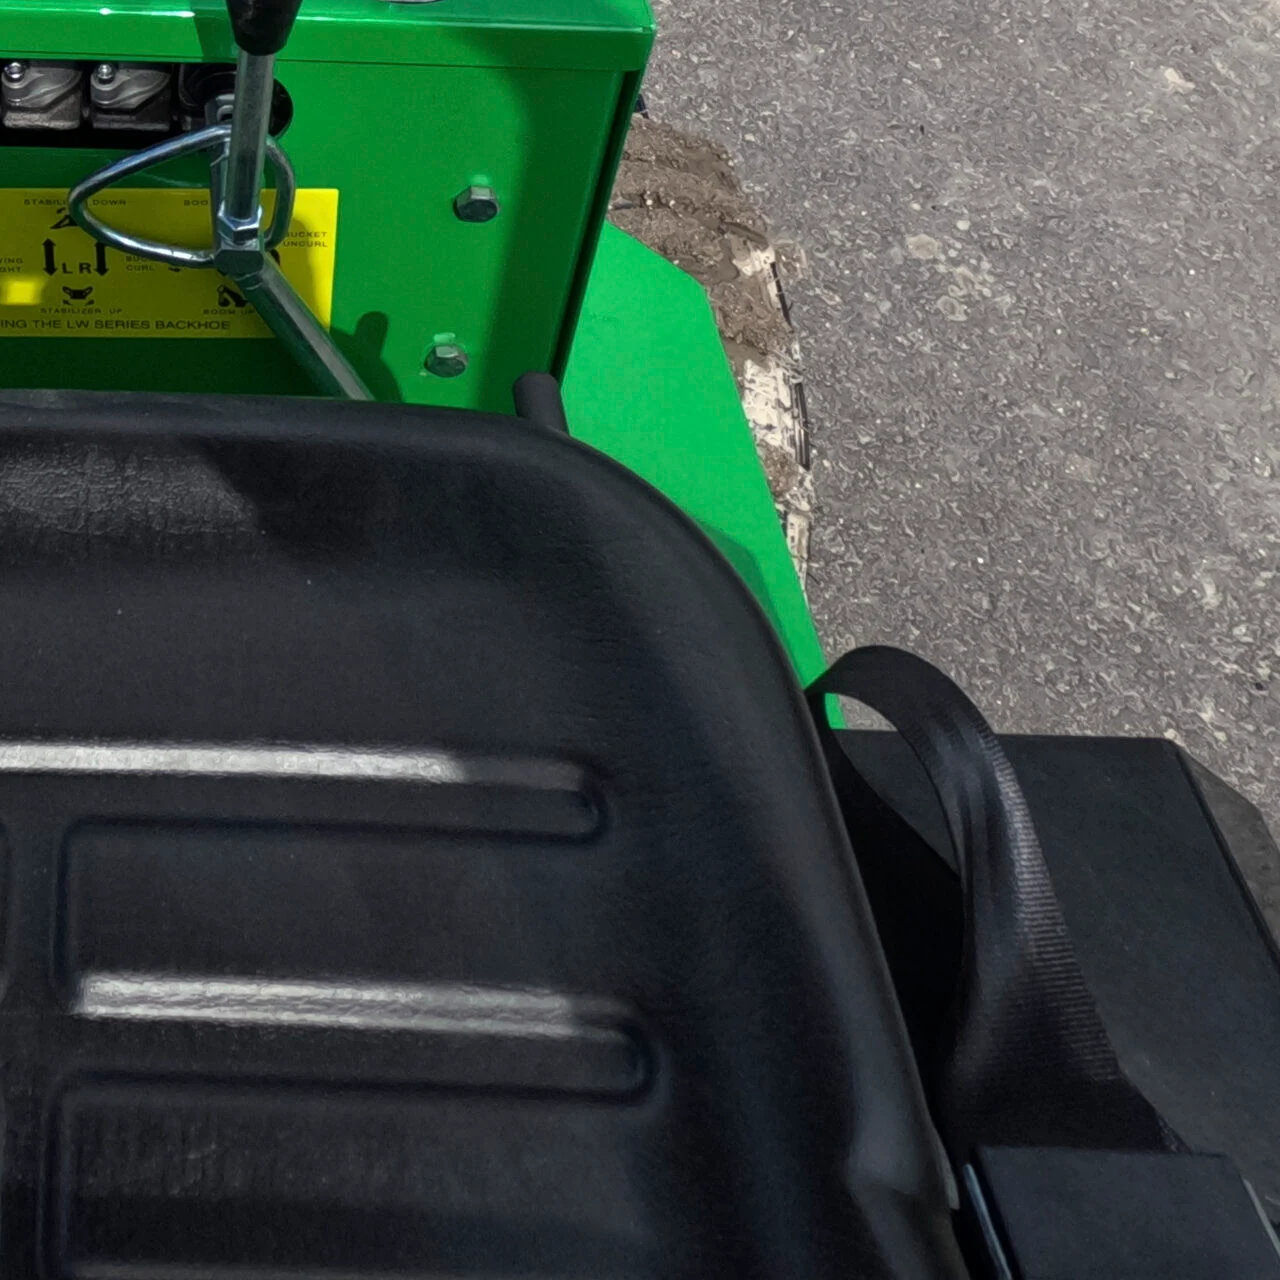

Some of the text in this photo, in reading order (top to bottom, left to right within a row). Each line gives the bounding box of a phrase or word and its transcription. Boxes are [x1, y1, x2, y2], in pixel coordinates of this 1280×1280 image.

[283, 240, 329, 248] UNCURL
[62, 262, 92, 274] L R
[32, 319, 62, 329] THE
[67, 319, 90, 329] LW
[94, 320, 150, 329] SERIES
[155, 320, 230, 330] BACKHOE
